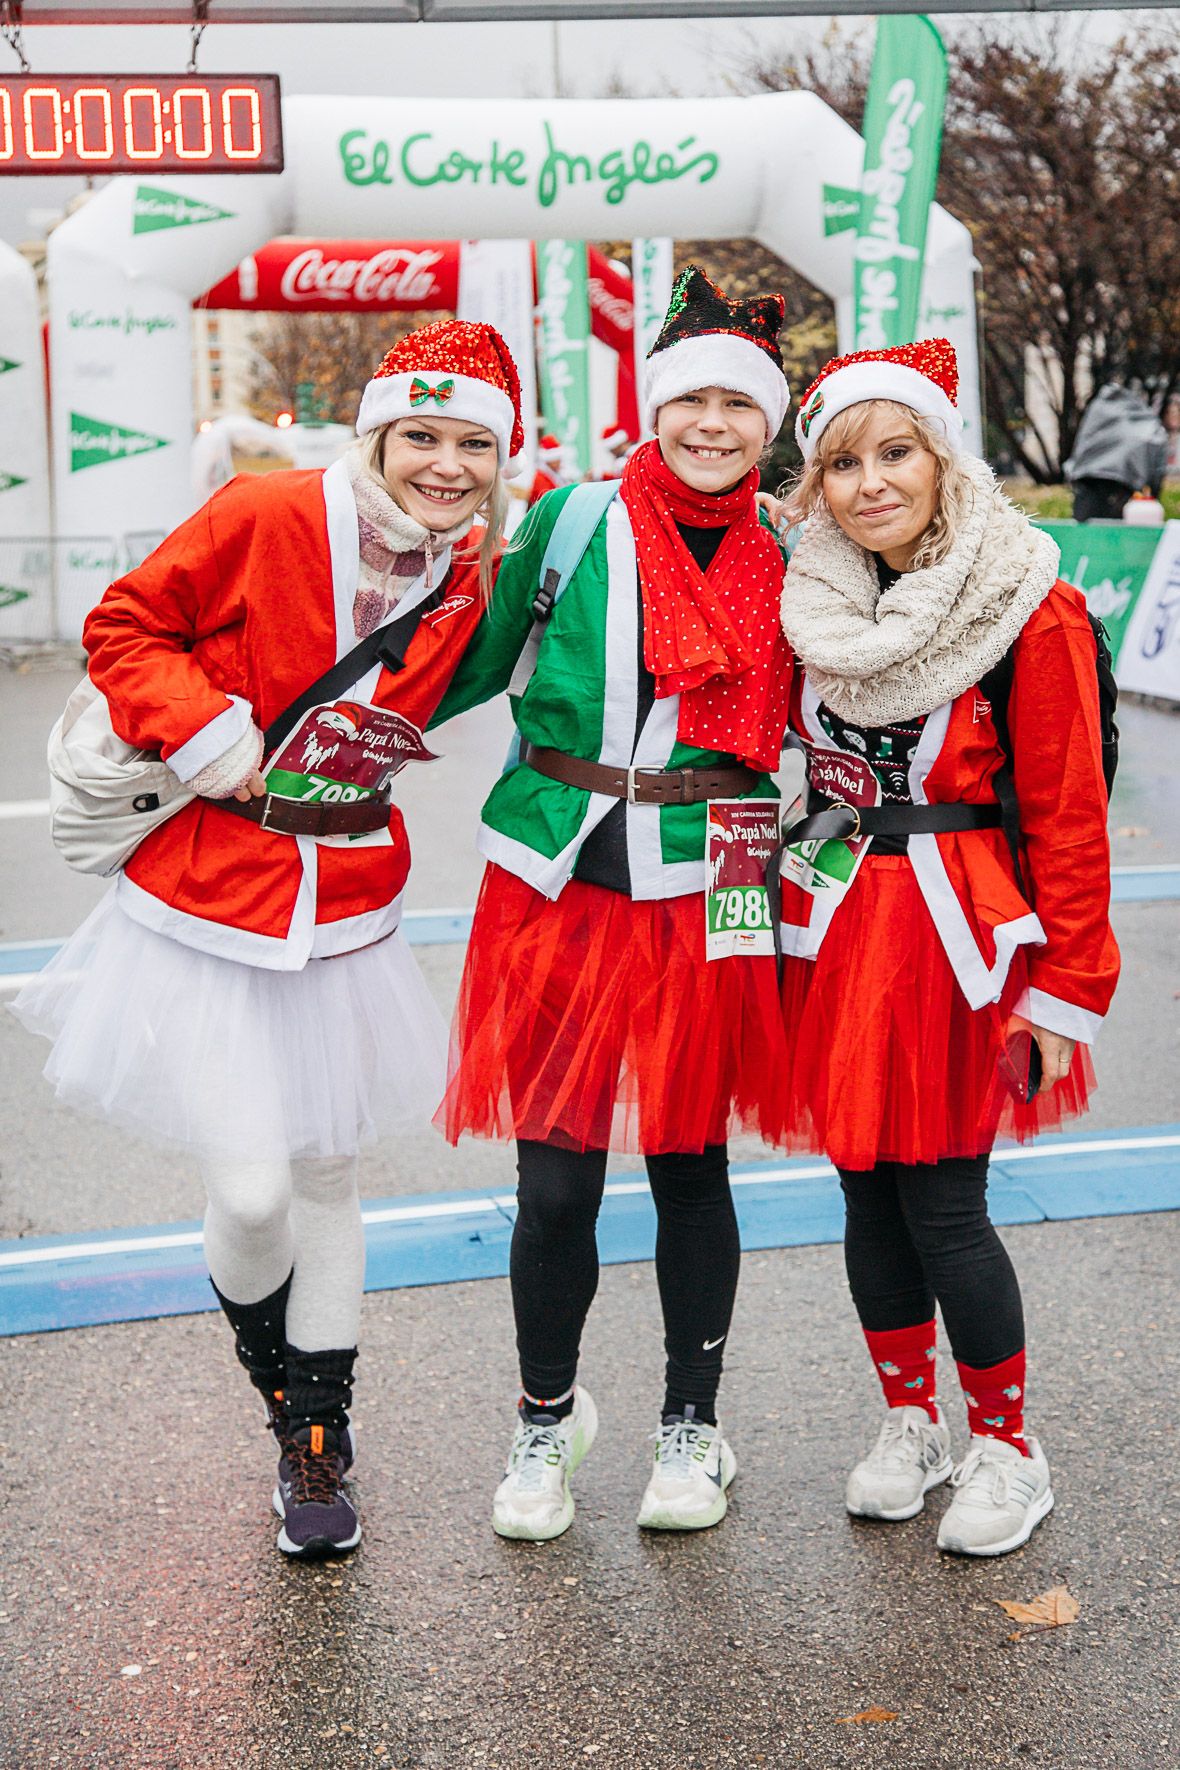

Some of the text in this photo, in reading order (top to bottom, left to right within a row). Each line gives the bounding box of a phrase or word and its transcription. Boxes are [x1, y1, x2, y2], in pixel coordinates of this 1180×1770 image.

[339, 119, 719, 207] El Corte Inglés
[281, 248, 445, 302] Coca-Cola
[357, 728, 392, 749] Papá
[832, 766, 865, 796] Noel
[730, 823, 761, 845] Papá
